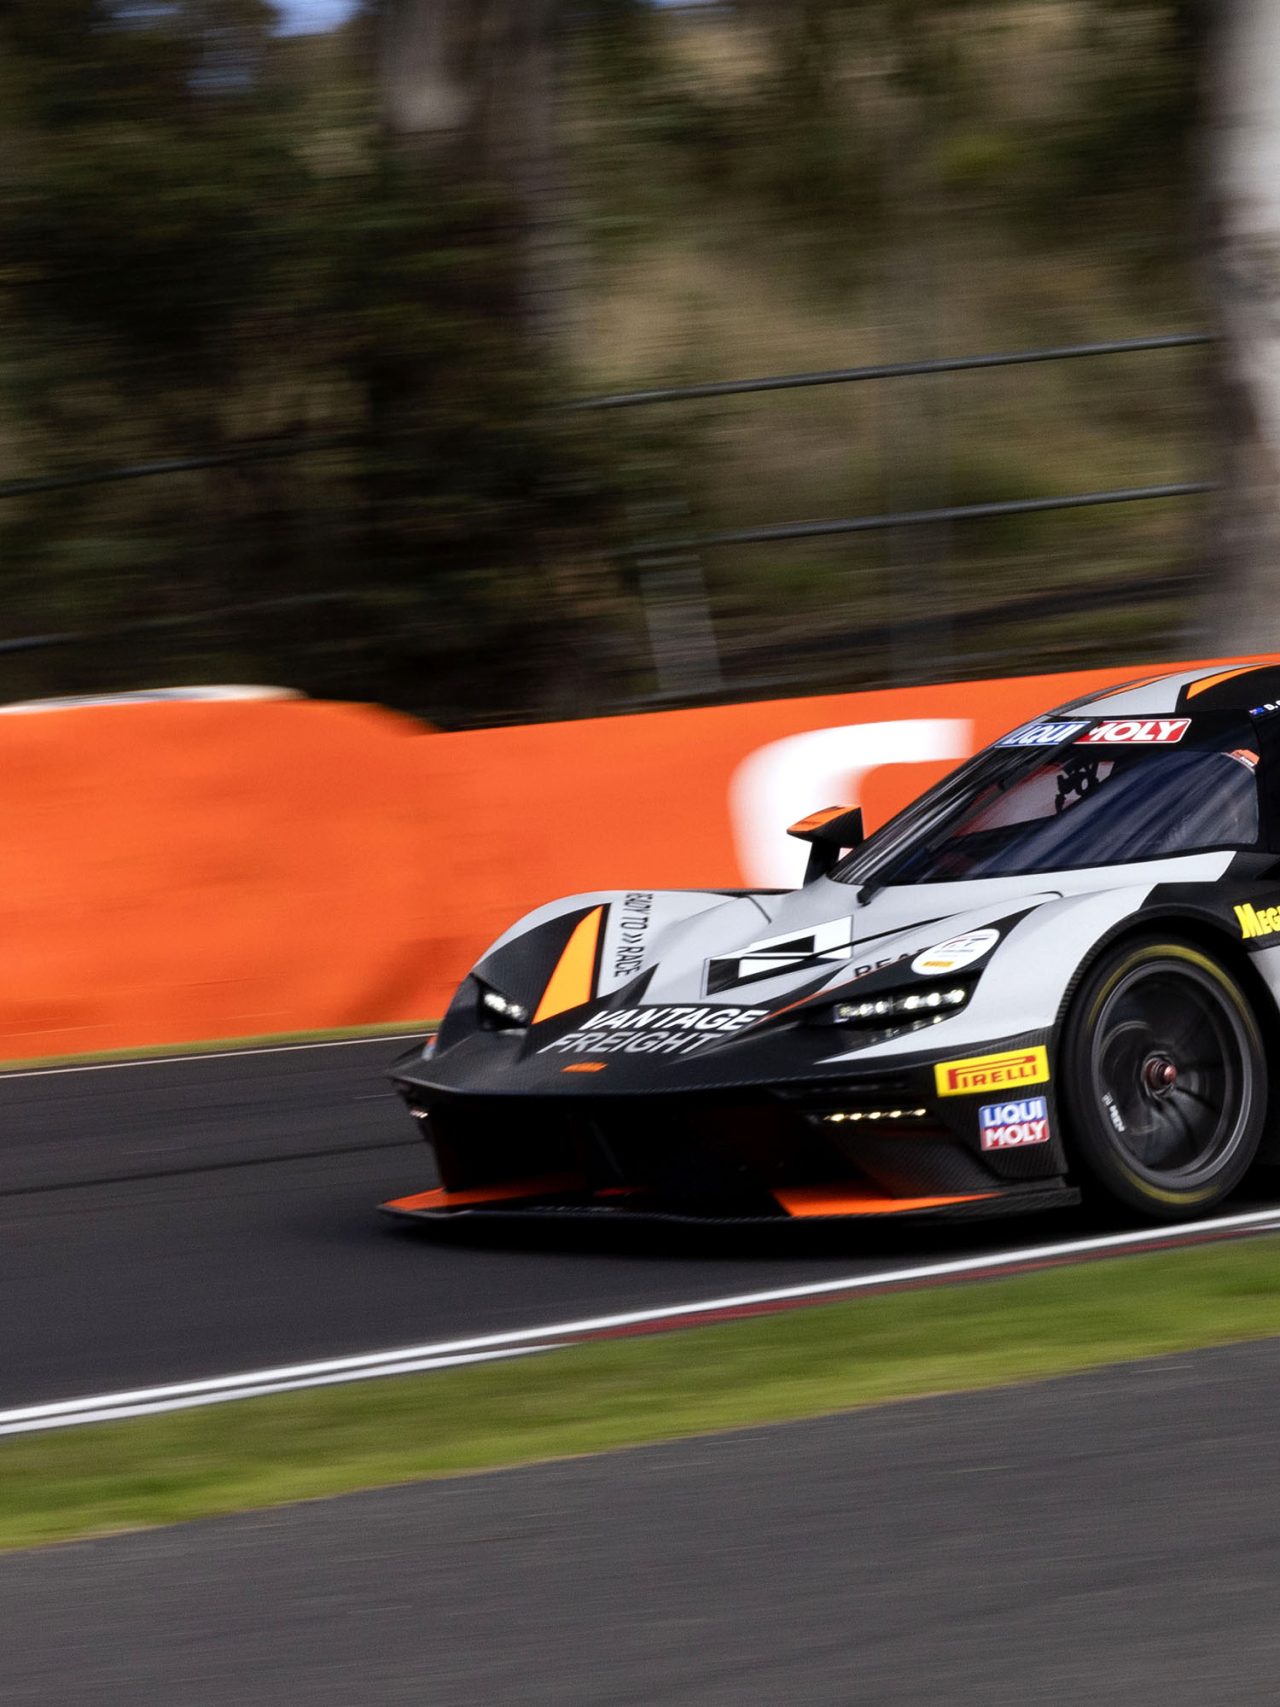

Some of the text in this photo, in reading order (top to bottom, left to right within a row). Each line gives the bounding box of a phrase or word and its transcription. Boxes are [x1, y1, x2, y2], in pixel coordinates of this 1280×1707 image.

[614, 893, 654, 978] EADY TO RACE
[578, 1007, 770, 1031] VANTAGE
[536, 1031, 725, 1055] FREIGHT
[947, 1055, 1037, 1090] PIRELLI
[983, 1100, 1043, 1127] LIQUI
[985, 1119, 1046, 1148] MOLY
